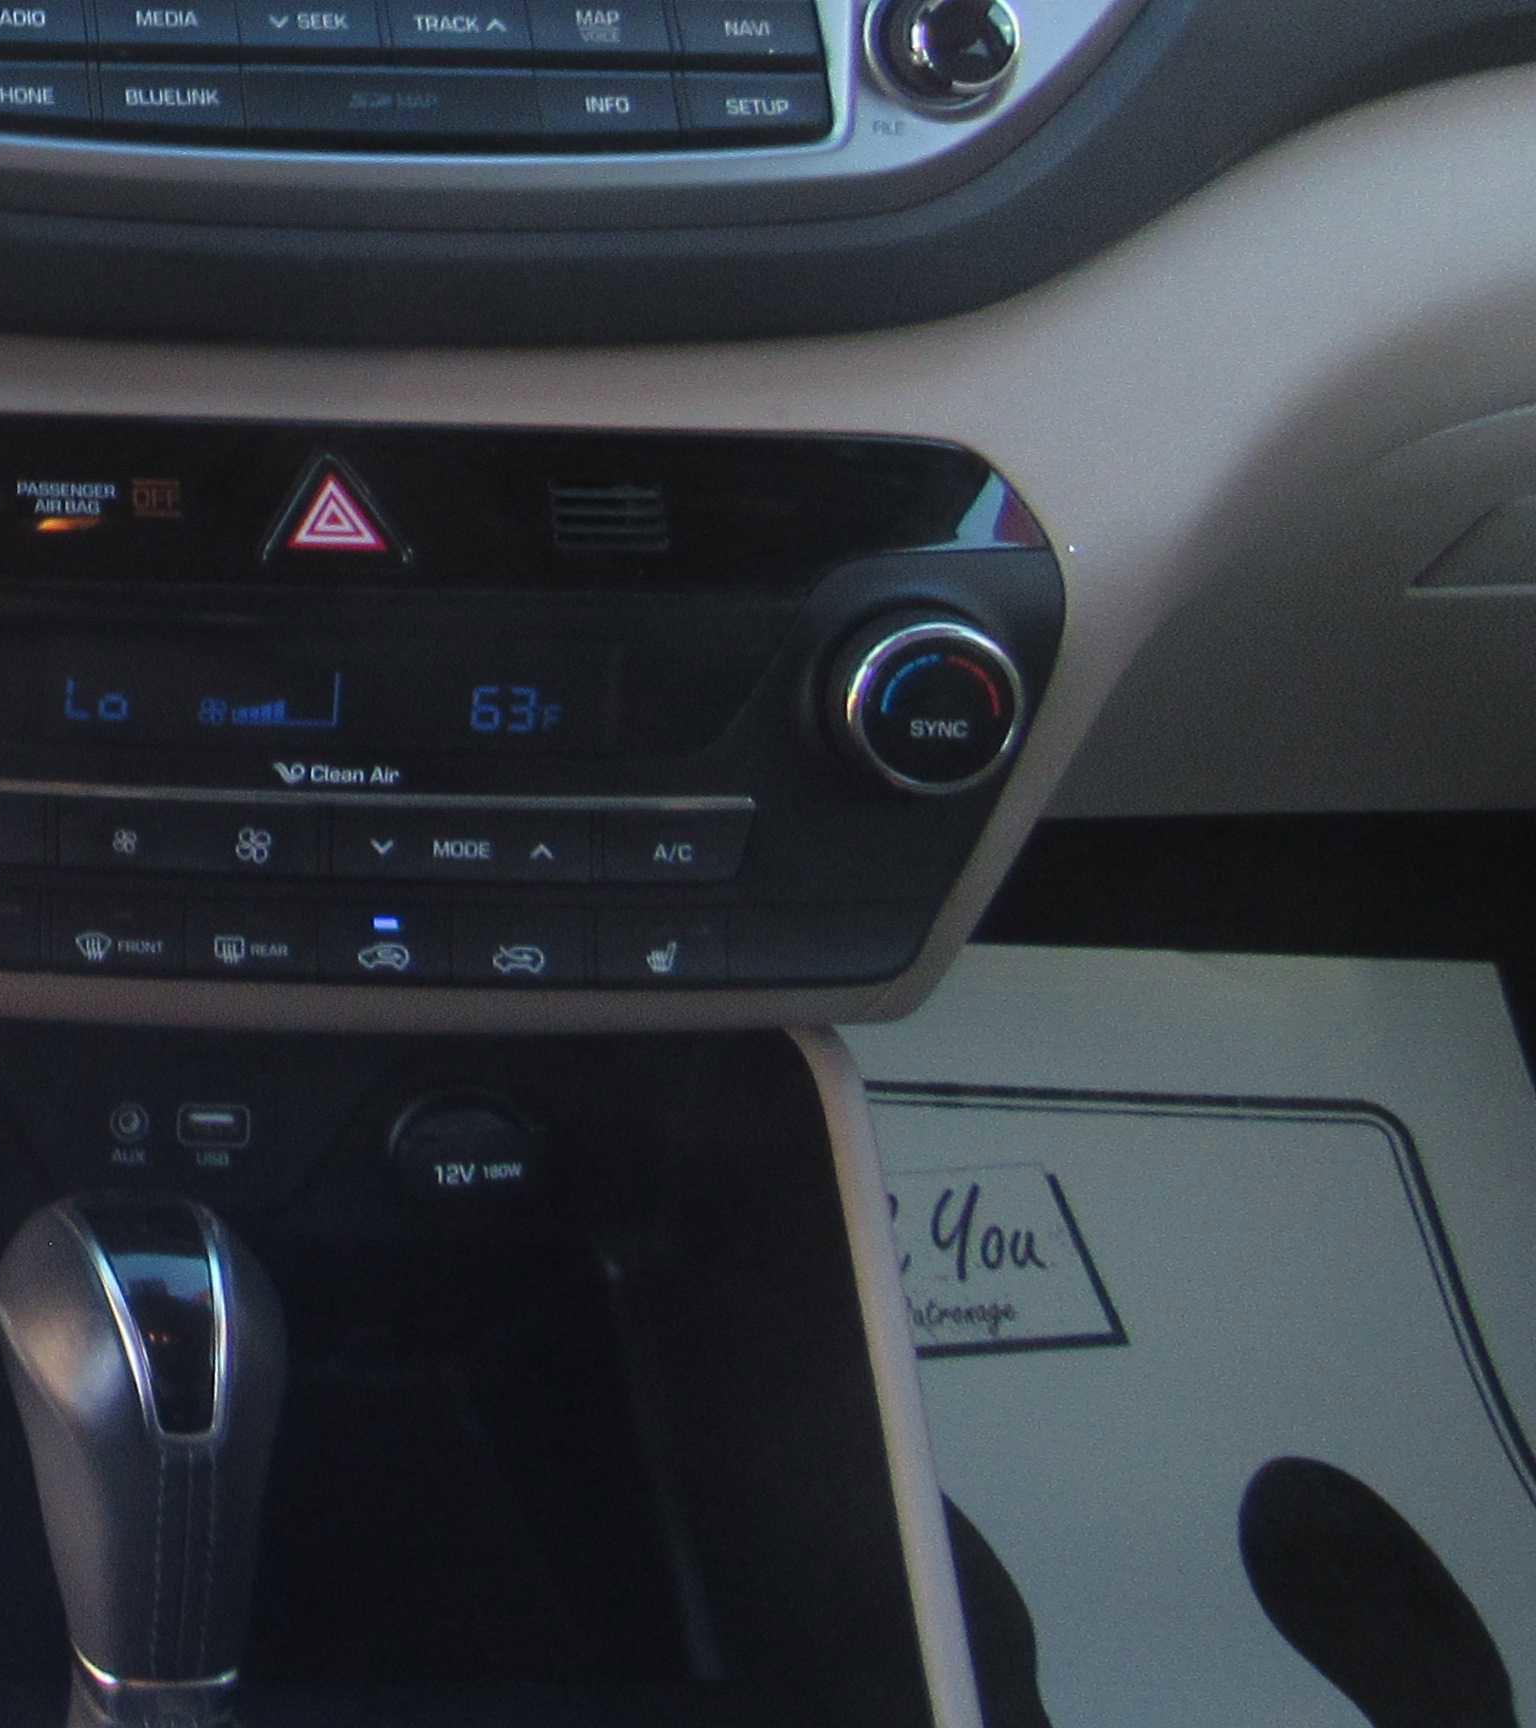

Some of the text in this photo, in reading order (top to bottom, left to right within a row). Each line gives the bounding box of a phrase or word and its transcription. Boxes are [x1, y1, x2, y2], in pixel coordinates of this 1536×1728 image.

[135, 9, 198, 29] MEDIA
[296, 12, 350, 31] SEEK
[413, 14, 479, 33] TRACK
[575, 9, 620, 29] MAP
[724, 20, 770, 38] NAVI
[124, 87, 220, 108] BLUELINK
[584, 96, 630, 114] INFO
[725, 97, 790, 116] SETUP
[16, 480, 117, 498] PASSENGER
[34, 498, 61, 514] AIR
[910, 718, 969, 740] SYNC
[309, 765, 400, 784] Clean Air
[433, 840, 491, 860] MODE
[653, 842, 693, 863] A/C
[117, 939, 165, 955] FRONT
[249, 943, 289, 958] REAR
[434, 1162, 476, 1185] 12V
[931, 1183, 1048, 1281] You
[904, 1294, 1017, 1337] atronage
